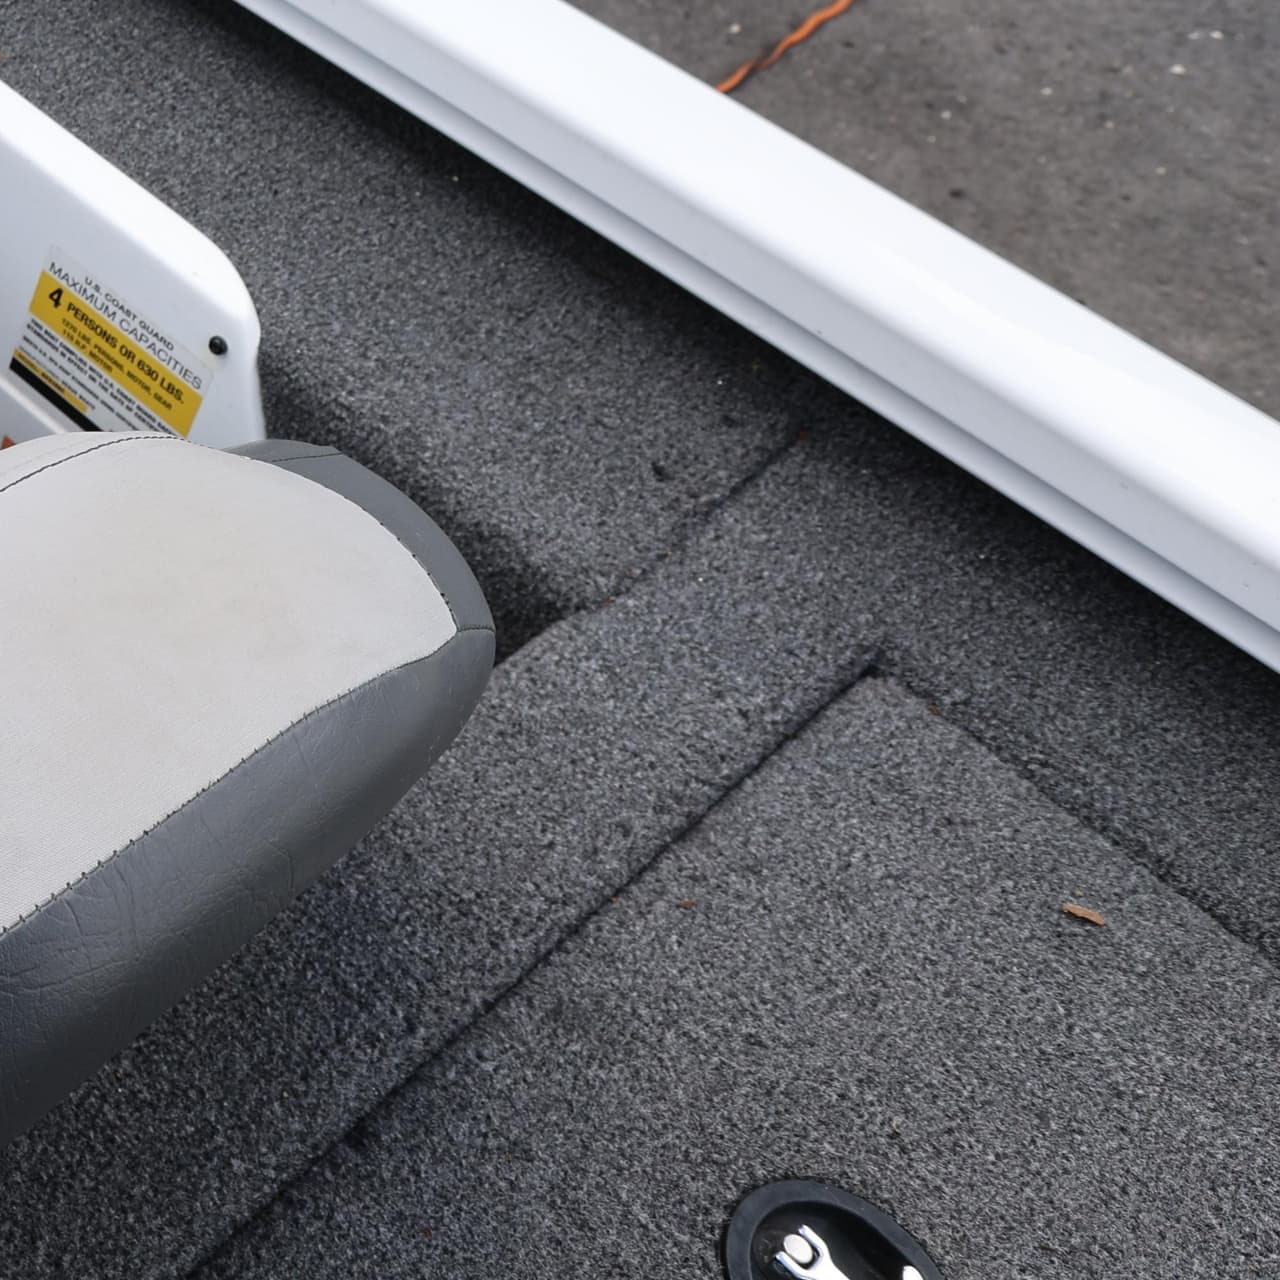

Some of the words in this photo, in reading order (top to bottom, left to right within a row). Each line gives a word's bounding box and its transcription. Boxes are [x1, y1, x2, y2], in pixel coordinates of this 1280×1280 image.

[48, 261, 116, 322] MAXIMUM
[117, 317, 203, 390] CAPACITIES
[48, 287, 63, 309] 4
[65, 300, 119, 350] PERSONS
[118, 344, 137, 364] OR
[135, 358, 159, 382] 630
[158, 377, 184, 404] LBS.
[103, 291, 137, 322] COAST
[138, 319, 174, 352] GUARD
